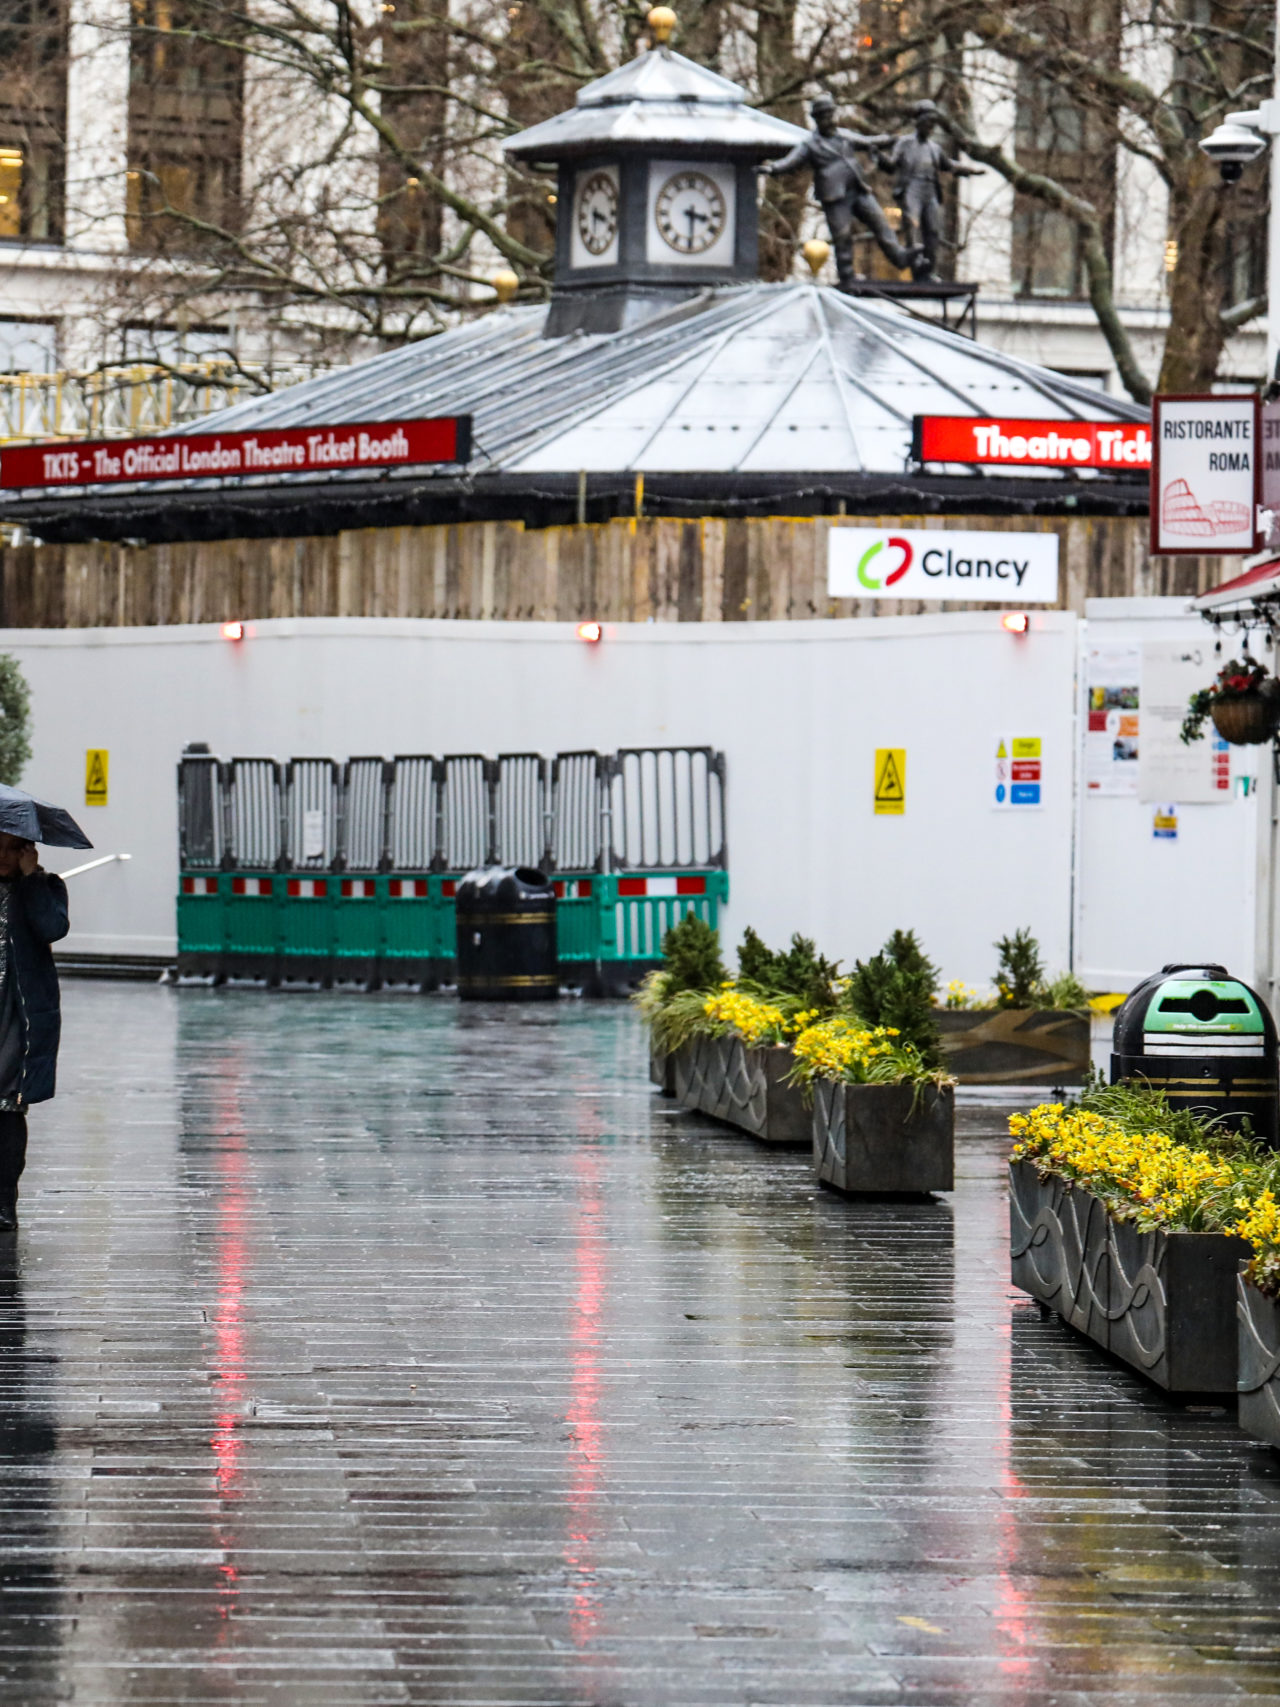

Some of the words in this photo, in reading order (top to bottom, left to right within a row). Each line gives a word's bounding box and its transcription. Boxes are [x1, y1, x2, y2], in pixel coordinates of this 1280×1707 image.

[973, 425, 1091, 460] Theatre
[1097, 429, 1152, 462] Tick
[1164, 420, 1250, 439] RISTORANTE
[43, 452, 79, 479] TKTS
[94, 448, 120, 476] The
[123, 443, 180, 474] Official
[182, 440, 241, 471] London
[243, 437, 306, 467] Theatre
[307, 432, 356, 463] Ticket
[358, 428, 409, 459] Booth
[1209, 452, 1250, 471] ROMA
[922, 549, 1029, 586] Clancy
